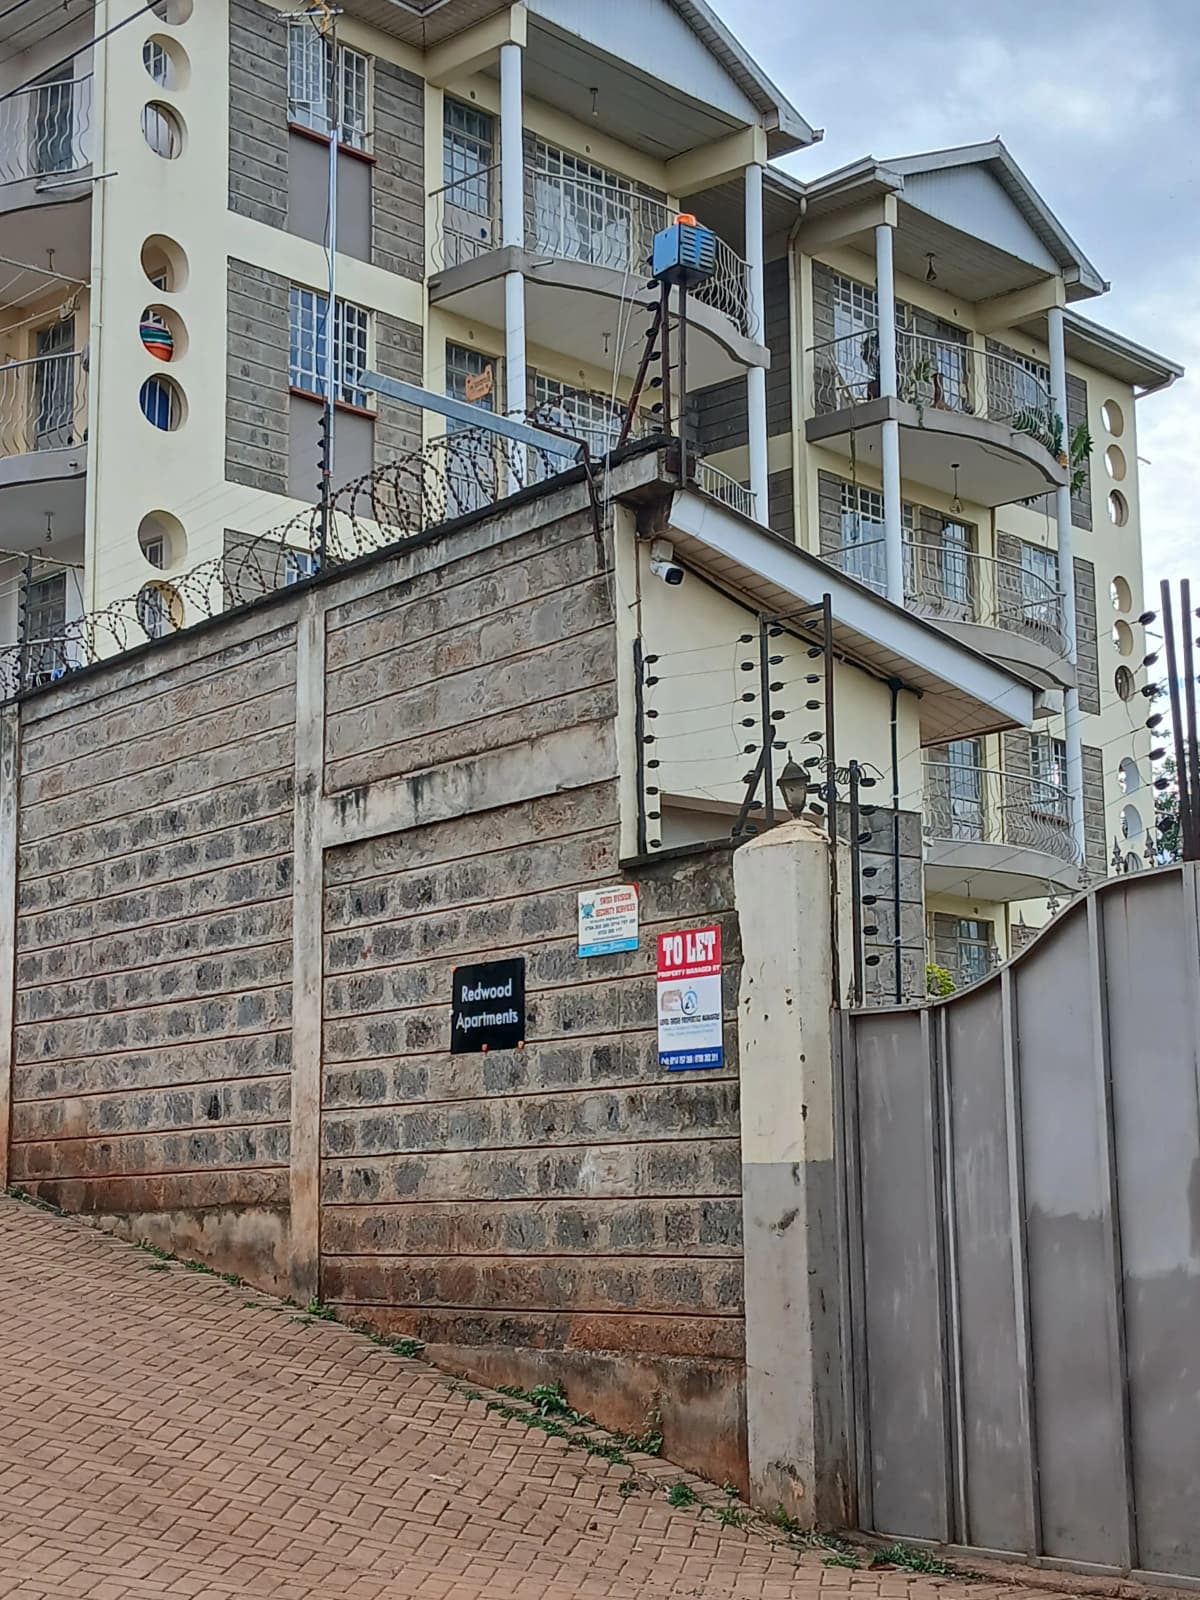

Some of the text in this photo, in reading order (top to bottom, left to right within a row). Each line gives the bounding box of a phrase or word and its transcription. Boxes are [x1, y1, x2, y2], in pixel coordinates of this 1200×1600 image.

[662, 931, 716, 967] TO LET
[657, 969, 686, 978] PROPERTY
[686, 965, 712, 975] MANAGED
[461, 977, 512, 1003] Redwood
[456, 1008, 519, 1034] Apartments
